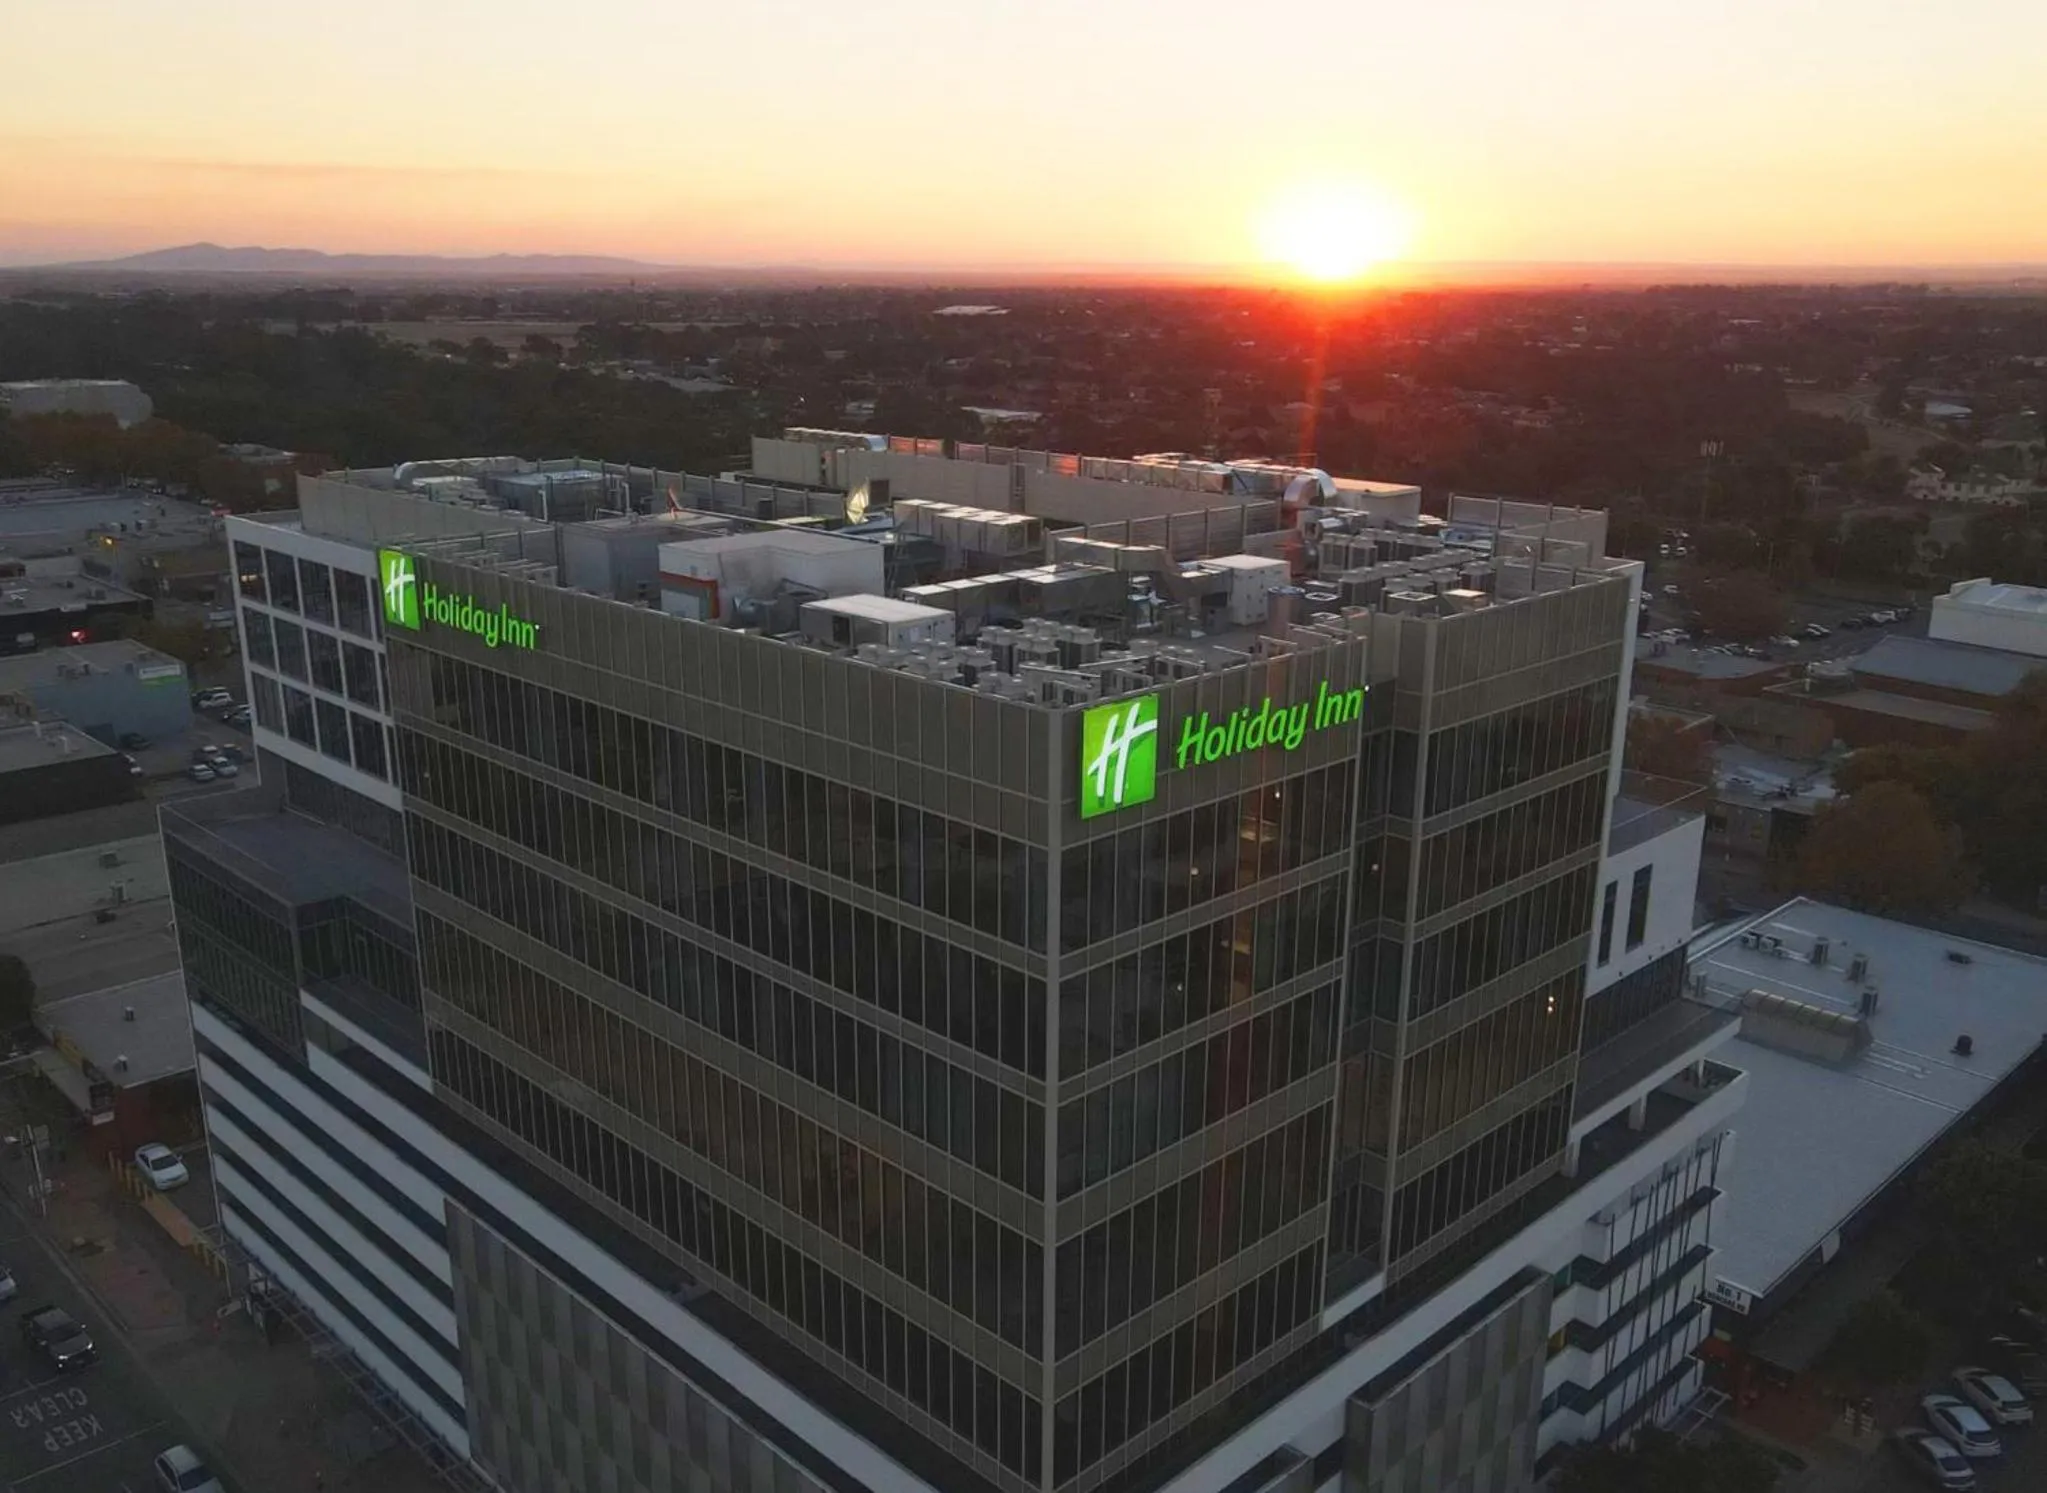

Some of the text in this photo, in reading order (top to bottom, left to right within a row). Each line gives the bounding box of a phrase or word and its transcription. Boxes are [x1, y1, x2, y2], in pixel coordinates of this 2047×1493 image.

[424, 581, 534, 650] Holiday Inn
[1176, 680, 1363, 769] Holiday Inn
[9, 1386, 88, 1429] CLEAR
[44, 1413, 104, 1452] KEEP
